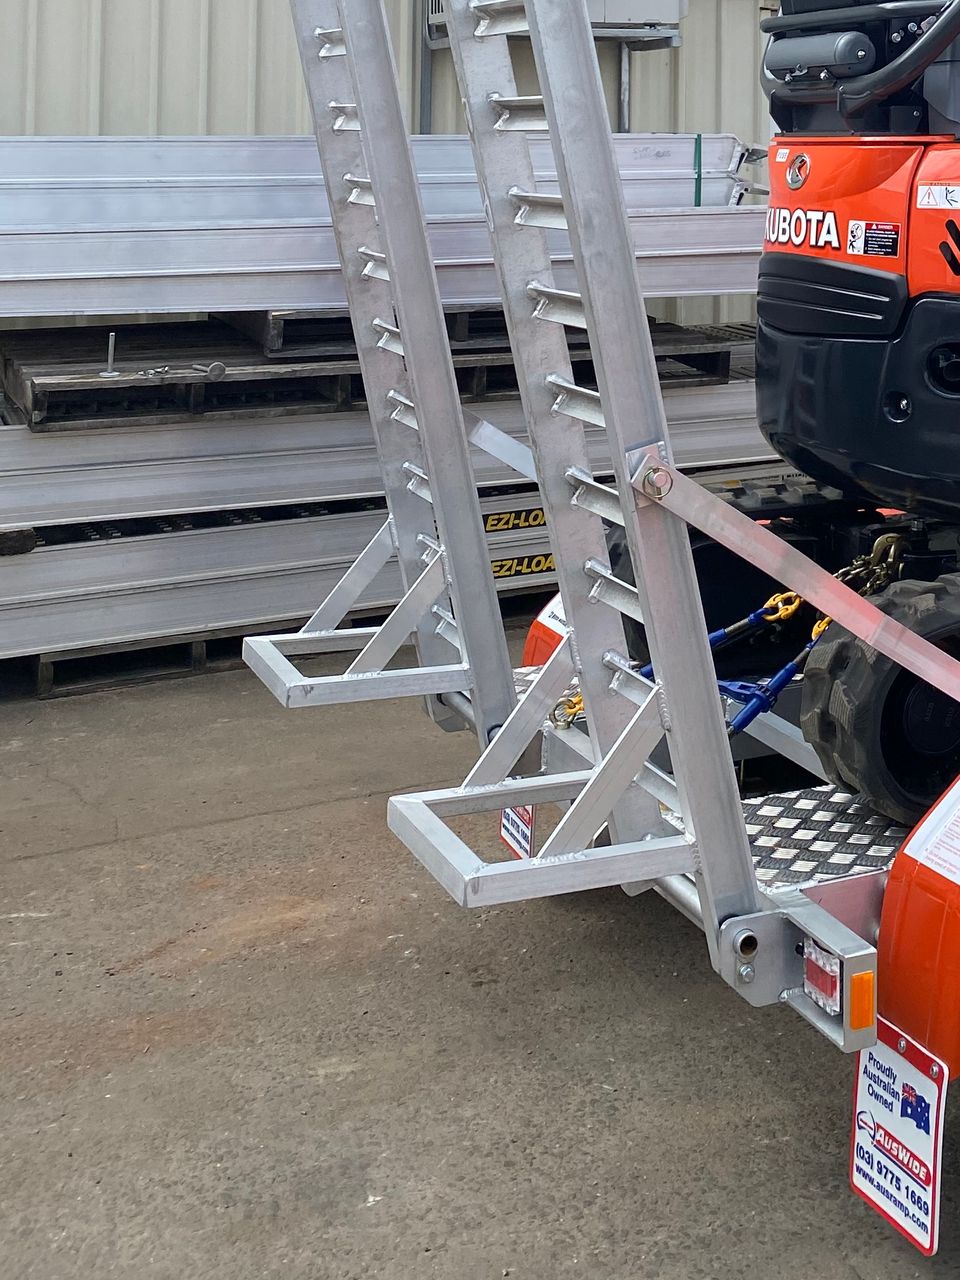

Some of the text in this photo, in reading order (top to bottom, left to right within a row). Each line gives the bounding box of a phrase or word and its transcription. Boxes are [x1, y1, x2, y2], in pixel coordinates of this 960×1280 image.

[485, 509, 546, 532] EZI-LO
[862, 1064, 901, 1103] Australian
[867, 1051, 898, 1086] Proudly
[867, 1083, 894, 1113] Owned
[855, 1141, 930, 1217] (03) 9775 1669
[855, 1162, 929, 1235] www.ausramp.com
